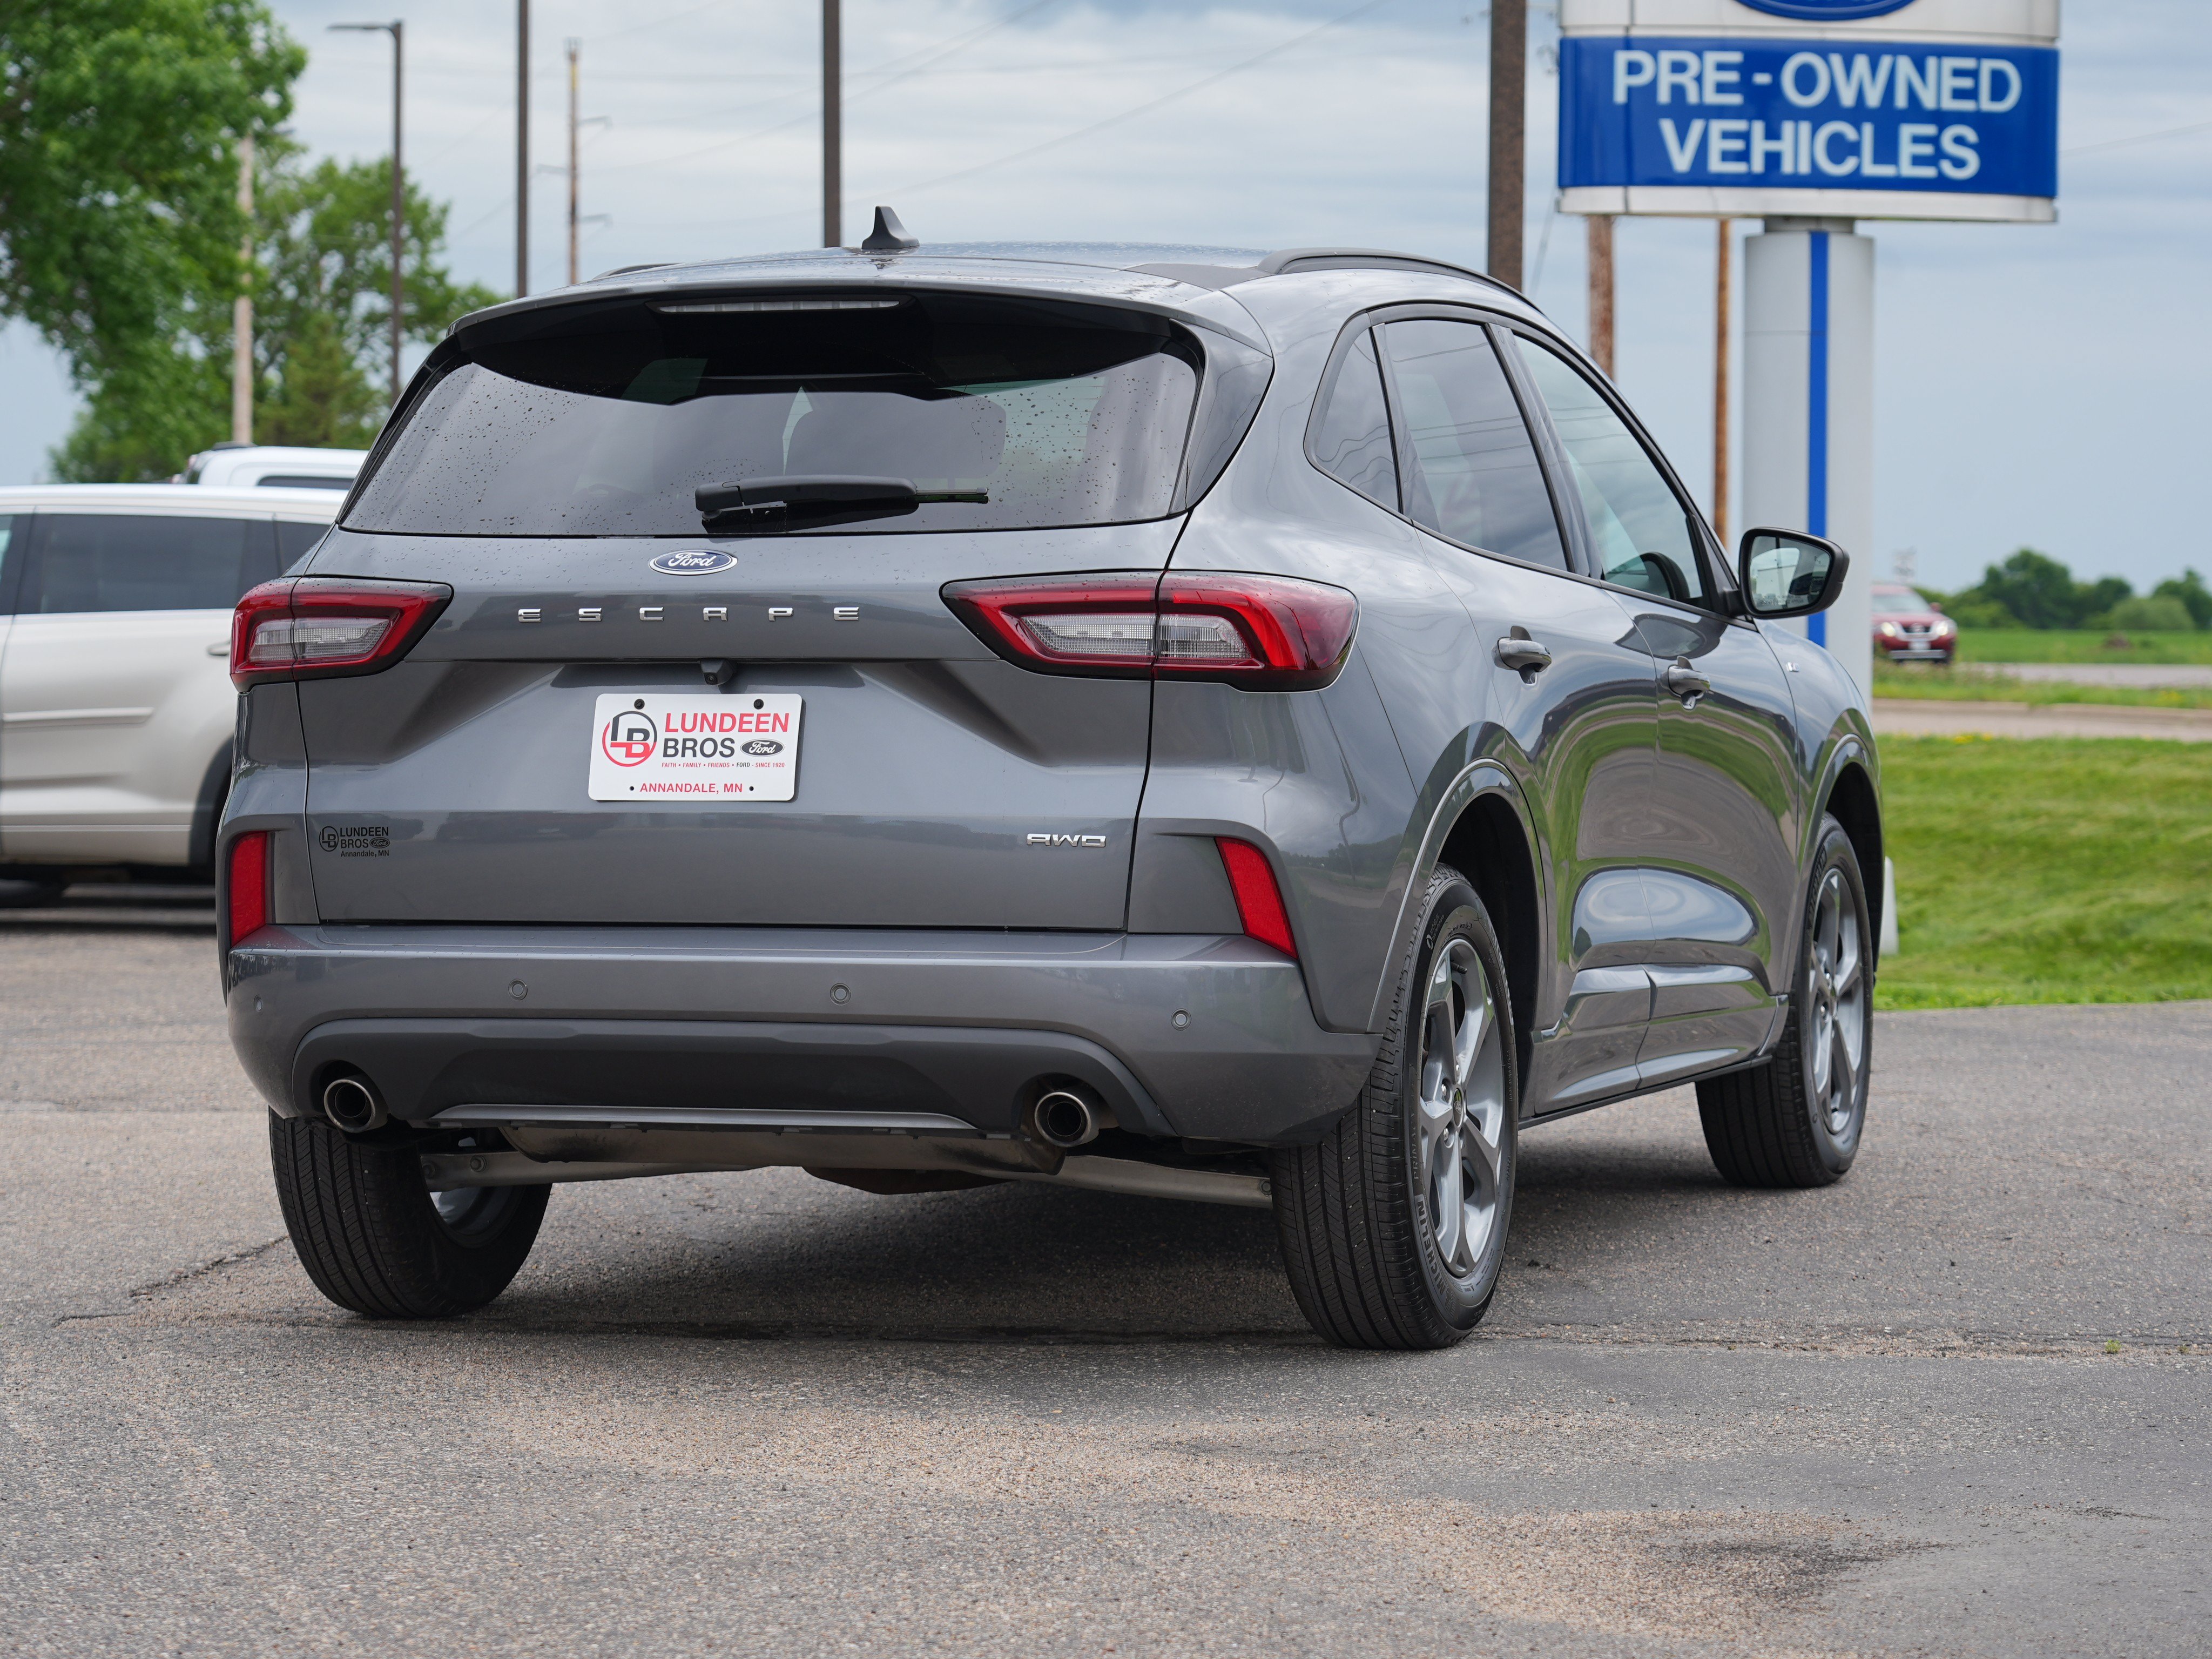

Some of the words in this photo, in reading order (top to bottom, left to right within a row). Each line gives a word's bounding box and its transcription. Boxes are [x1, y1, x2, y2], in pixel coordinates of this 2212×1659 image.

[1613, 50, 2022, 113] PRE-OWNED
[1659, 118, 1980, 180] VEHICLES
[668, 552, 717, 567] Ford
[518, 606, 860, 623] ESCAPE
[665, 713, 790, 733] LUNDEEN
[663, 738, 736, 758] BROS
[748, 742, 776, 754] Ford
[639, 783, 719, 794] ANNANDALE,
[724, 783, 743, 793] MN
[340, 827, 389, 837] LUNDEEN
[1027, 833, 1107, 847] AWD
[340, 839, 369, 848] BROS
[1417, 1201, 1446, 1296] MICHELIN
